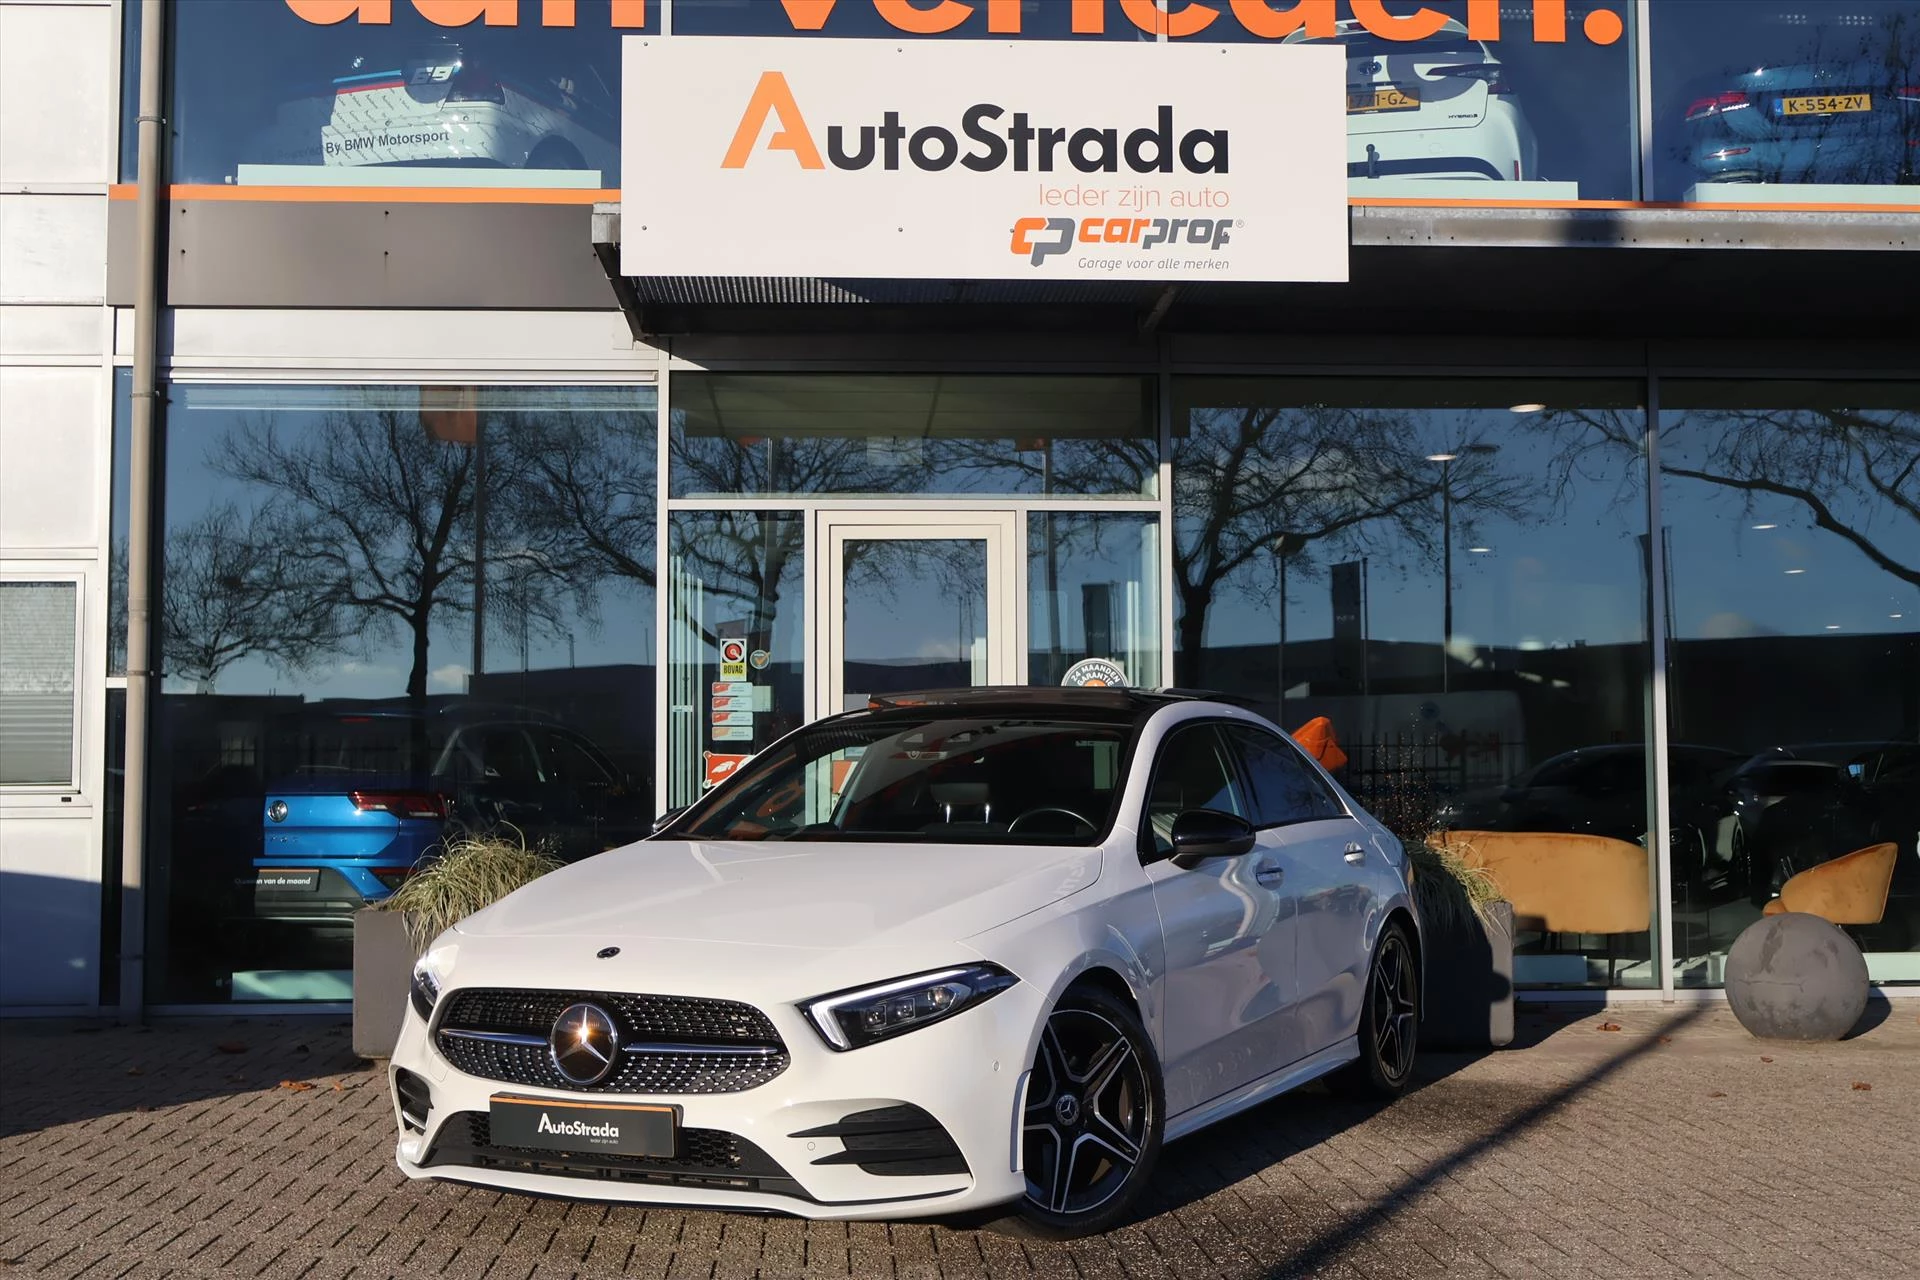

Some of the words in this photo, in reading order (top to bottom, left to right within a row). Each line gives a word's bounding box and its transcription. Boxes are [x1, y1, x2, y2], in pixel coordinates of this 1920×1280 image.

[1788, 97, 1863, 112] K-554-ZV
[720, 71, 1229, 174] AutoStrada
[325, 142, 341, 156] By
[345, 136, 375, 151] BMW
[378, 130, 450, 148] Motorsport
[1039, 184, 1110, 207] Ieder
[1118, 185, 1161, 213] zijn
[1170, 187, 1230, 208] auto
[1078, 257, 1122, 272] Garage
[1127, 259, 1154, 269] voor
[1158, 258, 1180, 270] alle
[1184, 258, 1230, 270] merken
[723, 665, 743, 674] BOVAG
[1071, 671, 1081, 681] 24
[1081, 664, 1120, 683] MAANDEN
[1077, 671, 1115, 686] GARANTIE
[277, 877, 286, 885] de
[287, 877, 311, 885] maand
[537, 1112, 619, 1138] AutoStrada
